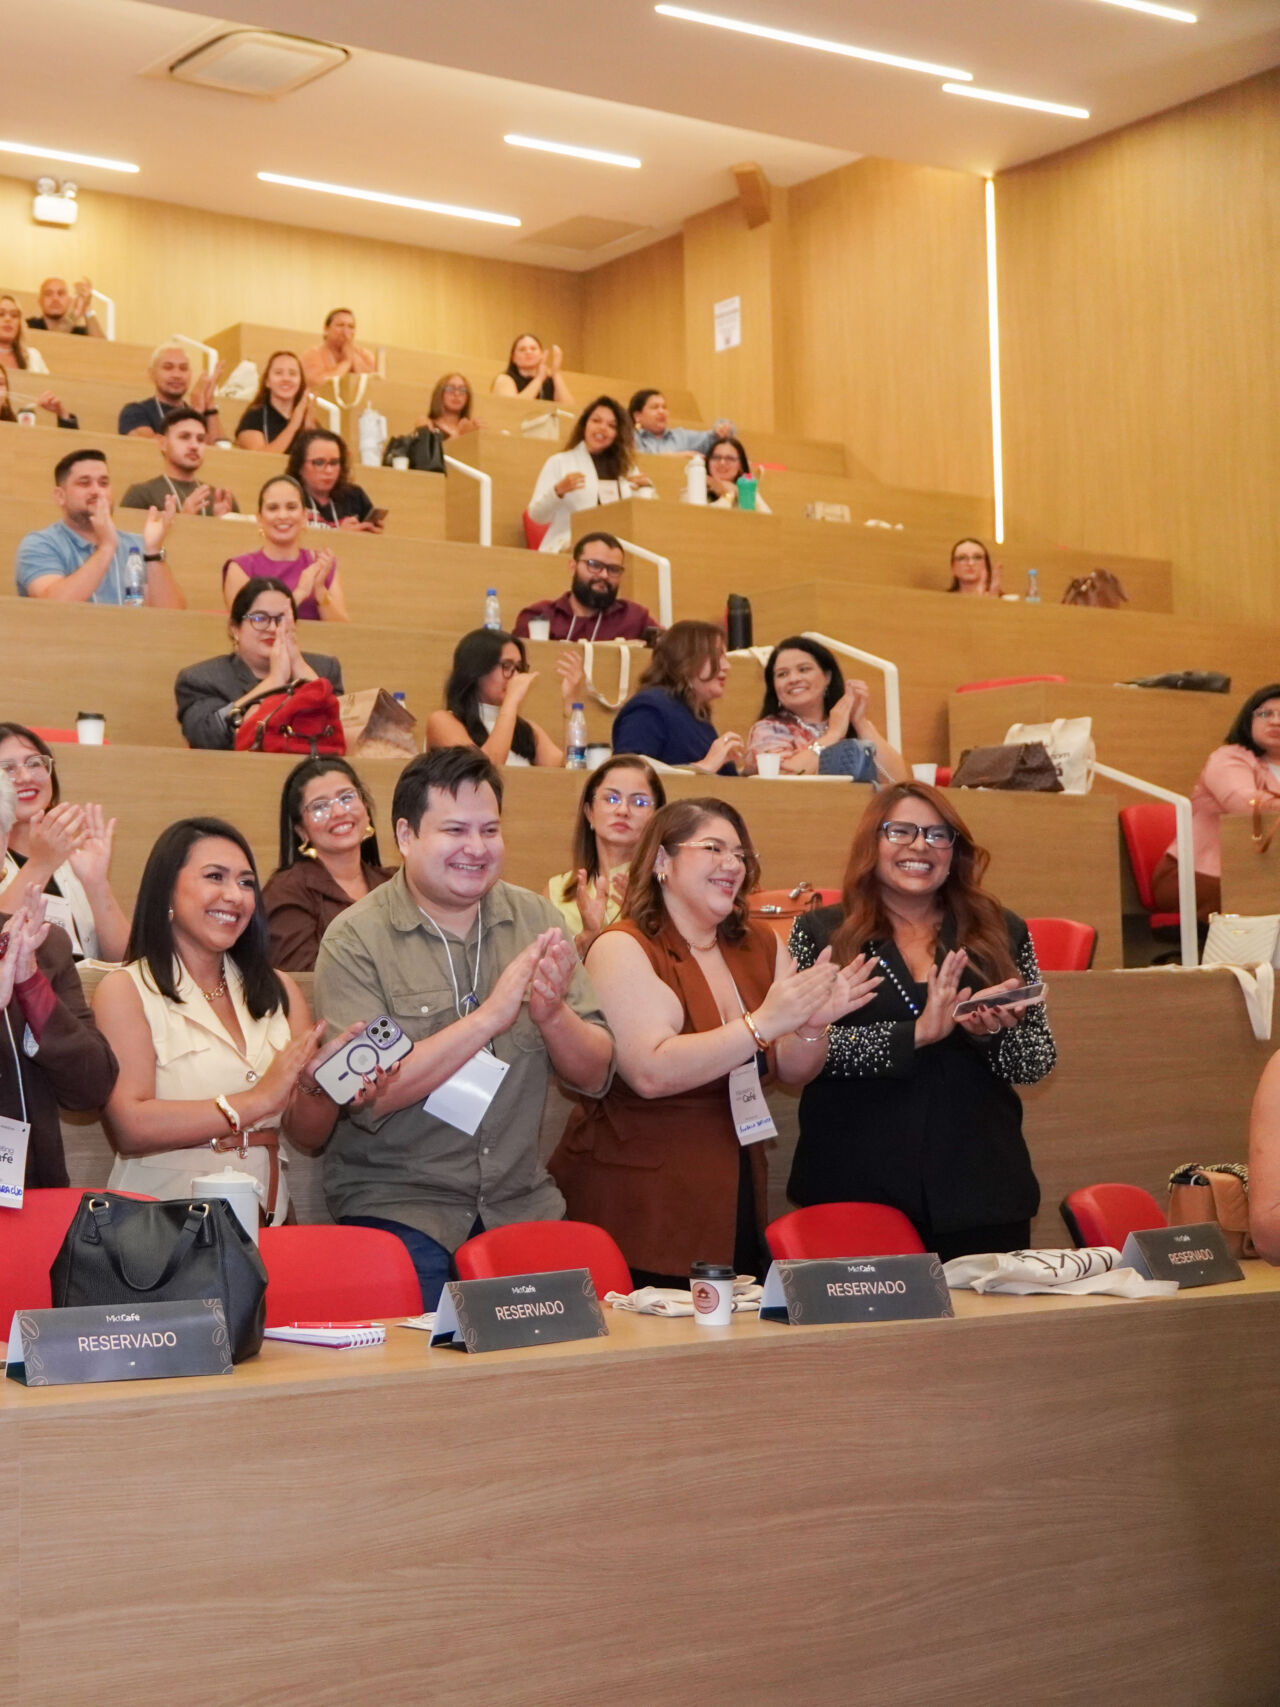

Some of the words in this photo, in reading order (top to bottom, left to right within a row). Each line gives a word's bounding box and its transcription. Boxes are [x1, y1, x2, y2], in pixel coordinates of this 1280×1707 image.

[1167, 1248, 1214, 1264] RESERVADO
[826, 1280, 906, 1297] RESERVADO
[495, 1300, 565, 1321] RESERVADO
[77, 1331, 177, 1352] RESERVADO
